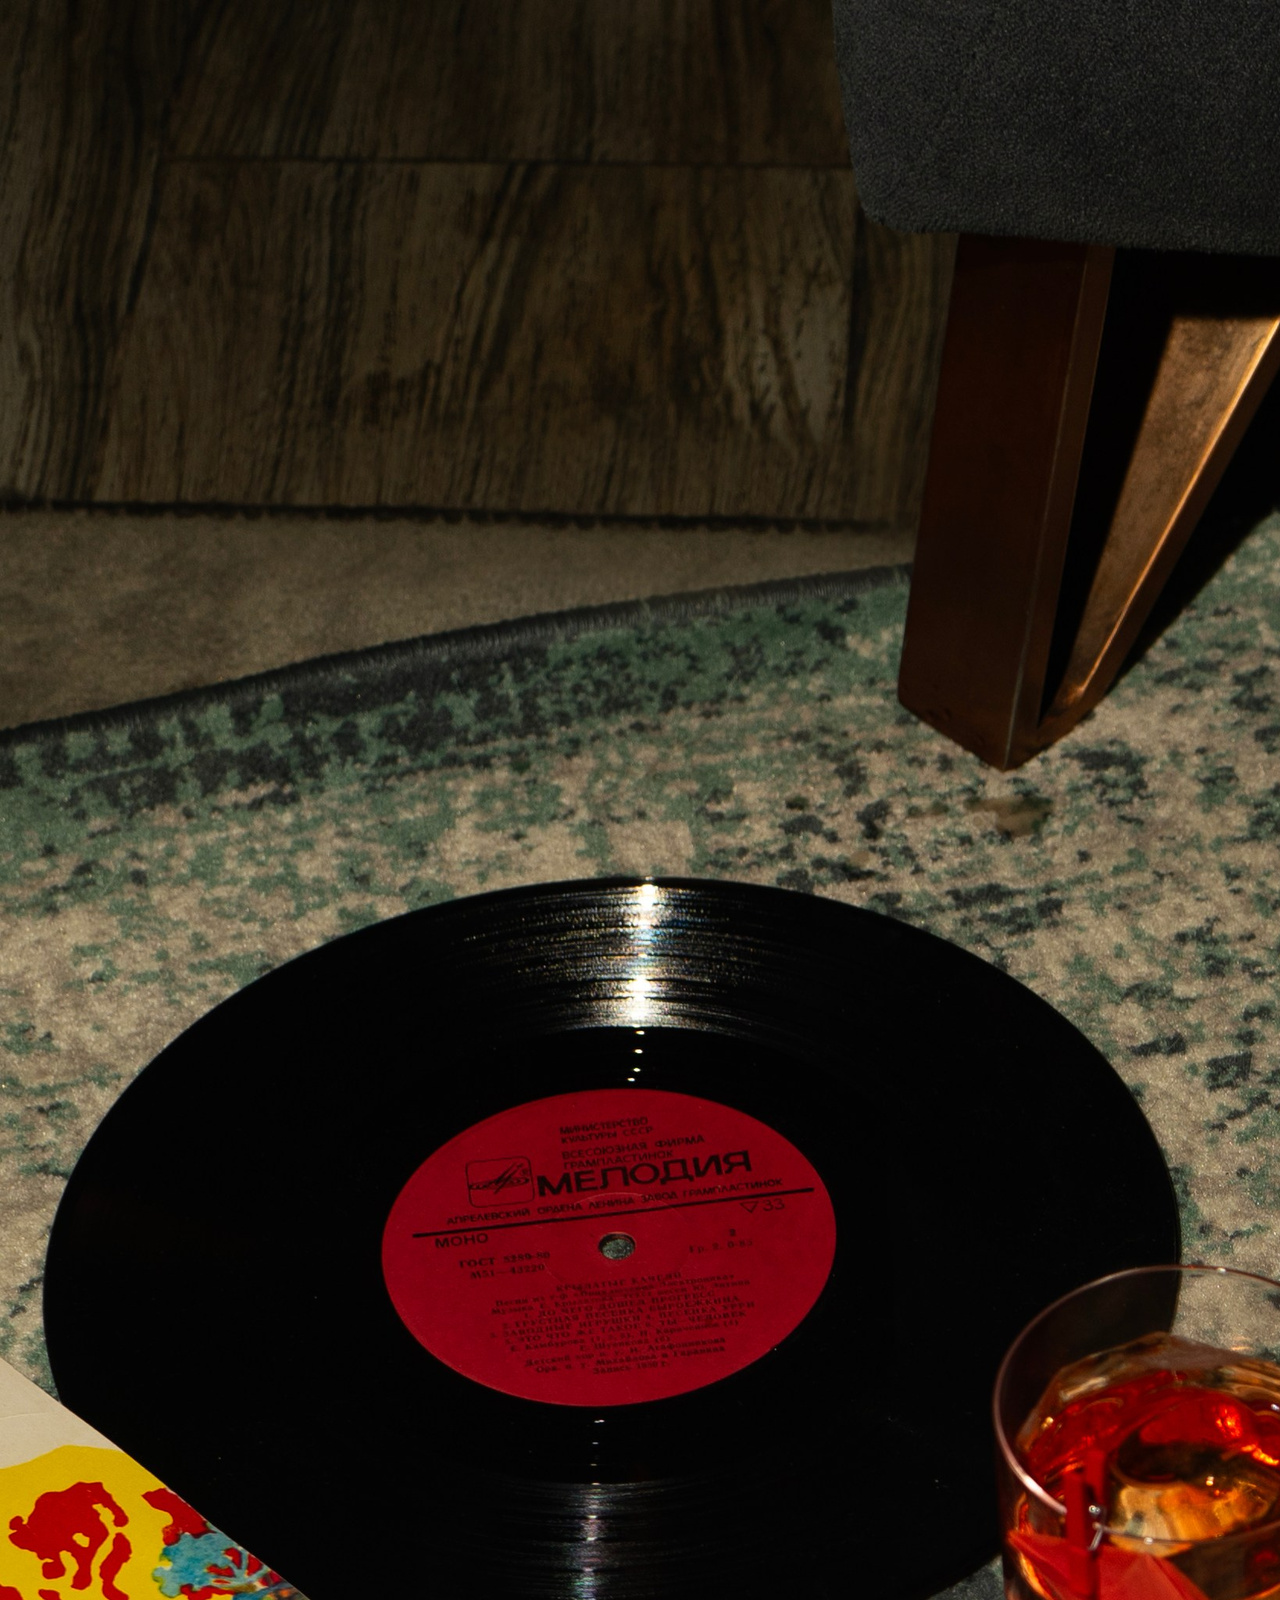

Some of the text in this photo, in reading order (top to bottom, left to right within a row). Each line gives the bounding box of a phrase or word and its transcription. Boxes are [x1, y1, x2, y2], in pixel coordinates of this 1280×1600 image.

[560, 1116, 649, 1135] МИНИСТЕРСТВО
[561, 1126, 653, 1144] КУЛЬТУРЫ СССР
[562, 1134, 705, 1160] ВСЕСОЮЗНАЯ ФИРМА
[564, 1150, 674, 1170] ГРАМПЛАСТИНОК
[537, 1150, 752, 1197] МЕЛОДИЯ
[447, 1178, 783, 1225] АПРЕЛЕВСКИЙ ОРДЕНА ЛЕНИНА ЗАВОД ГРАМПЛАСТИНОК
[763, 1198, 785, 1212] 33
[435, 1233, 489, 1249] МОНО
[458, 1257, 496, 1269] ГОСТ
